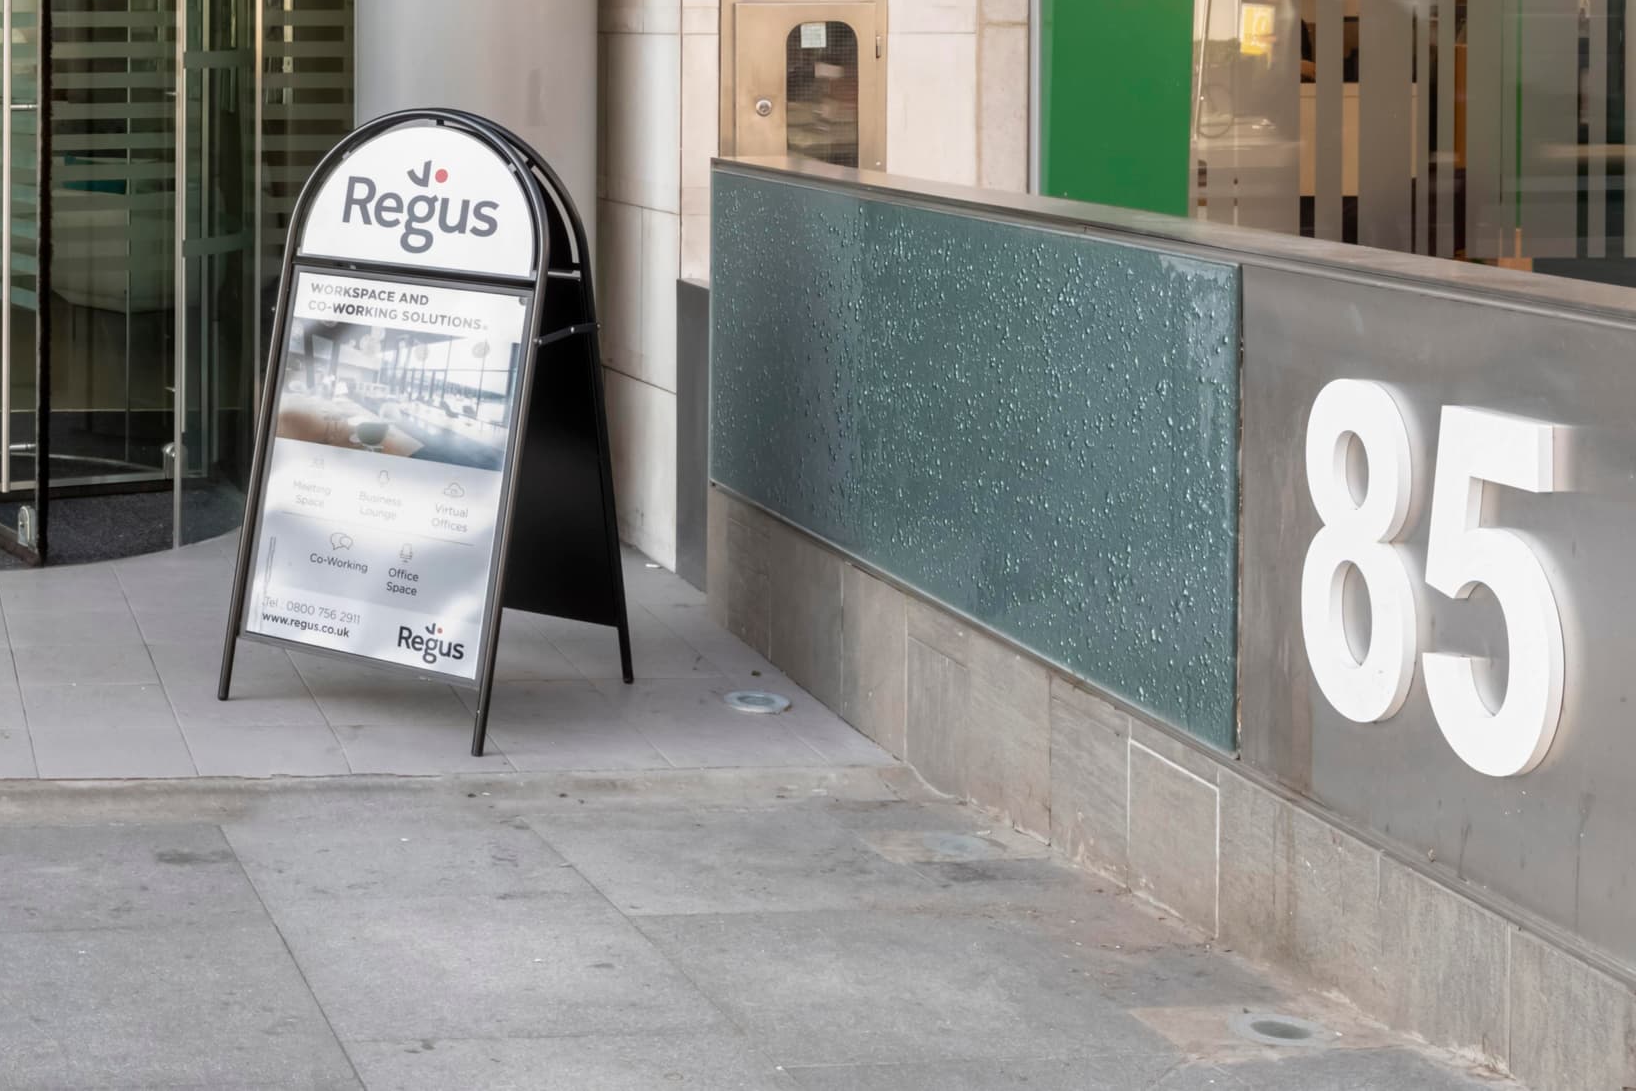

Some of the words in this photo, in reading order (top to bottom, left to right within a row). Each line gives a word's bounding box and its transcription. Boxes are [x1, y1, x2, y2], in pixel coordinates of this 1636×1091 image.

[342, 175, 500, 254] Regus
[310, 283, 395, 302] WORKSPACE
[398, 292, 429, 306] AND
[308, 300, 398, 320] CO-WORKING
[293, 479, 331, 497] Meeting
[295, 494, 325, 509] Space
[359, 491, 402, 507] Business
[359, 507, 397, 522] Lounge
[435, 503, 469, 518] Virtual
[431, 518, 468, 533] Offices
[309, 552, 369, 574] Co-Working
[388, 567, 419, 582] Office
[1301, 378, 1565, 777] 85
[386, 581, 418, 597] Space
[286, 600, 315, 616] 0800
[318, 607, 337, 620] 756
[262, 612, 350, 638] www.regus.co.uk
[397, 625, 465, 664] Regus
